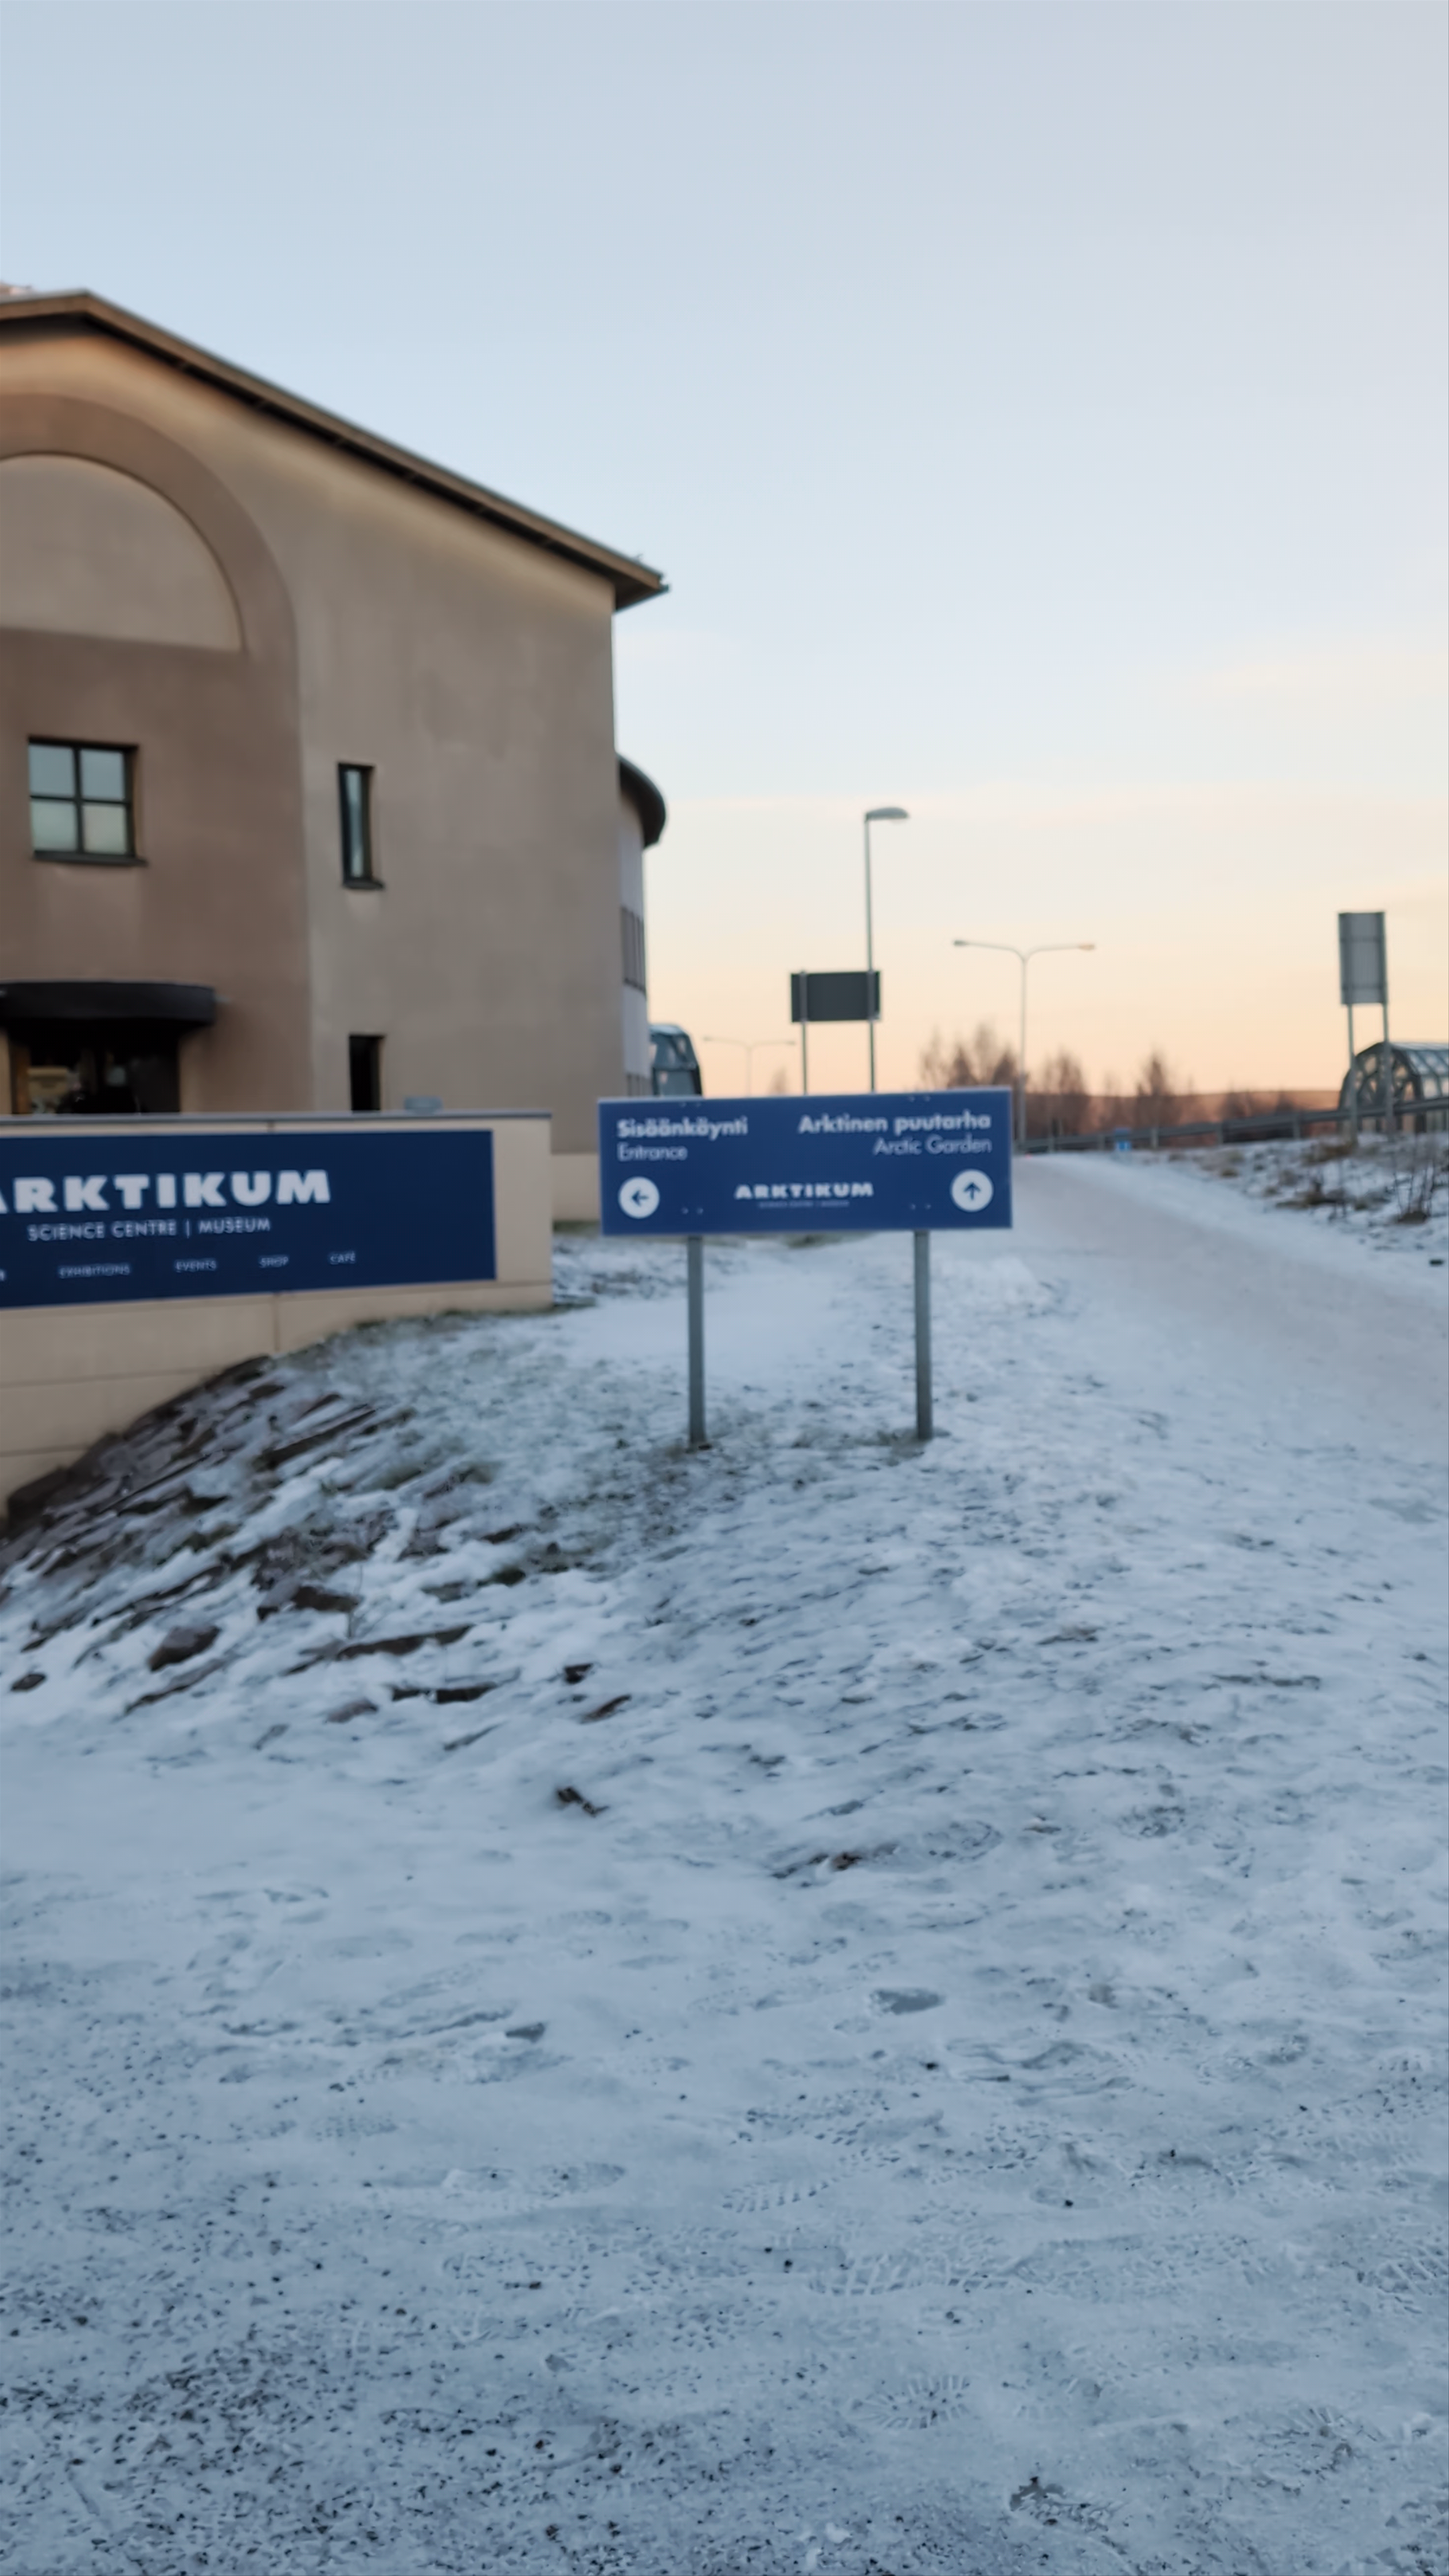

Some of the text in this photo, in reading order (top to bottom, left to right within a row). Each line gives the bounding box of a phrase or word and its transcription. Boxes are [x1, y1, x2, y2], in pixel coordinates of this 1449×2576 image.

[617, 1115, 749, 1141] Sisäänkäynti
[798, 1109, 991, 1135] Arktinen puutarha
[617, 1142, 688, 1161] Entrance
[873, 1133, 992, 1155] Arctic Garden
[0, 1169, 331, 1213] RKTIKUM
[735, 1181, 874, 1199] ARKTIKUM
[27, 1222, 106, 1241] SCIENCE
[112, 1218, 177, 1238] CENTRE
[198, 1216, 271, 1234] MUSEUM
[58, 1263, 131, 1279] EXHIBITIONS
[175, 1258, 218, 1272] EVENTS
[259, 1255, 289, 1268] SHOP
